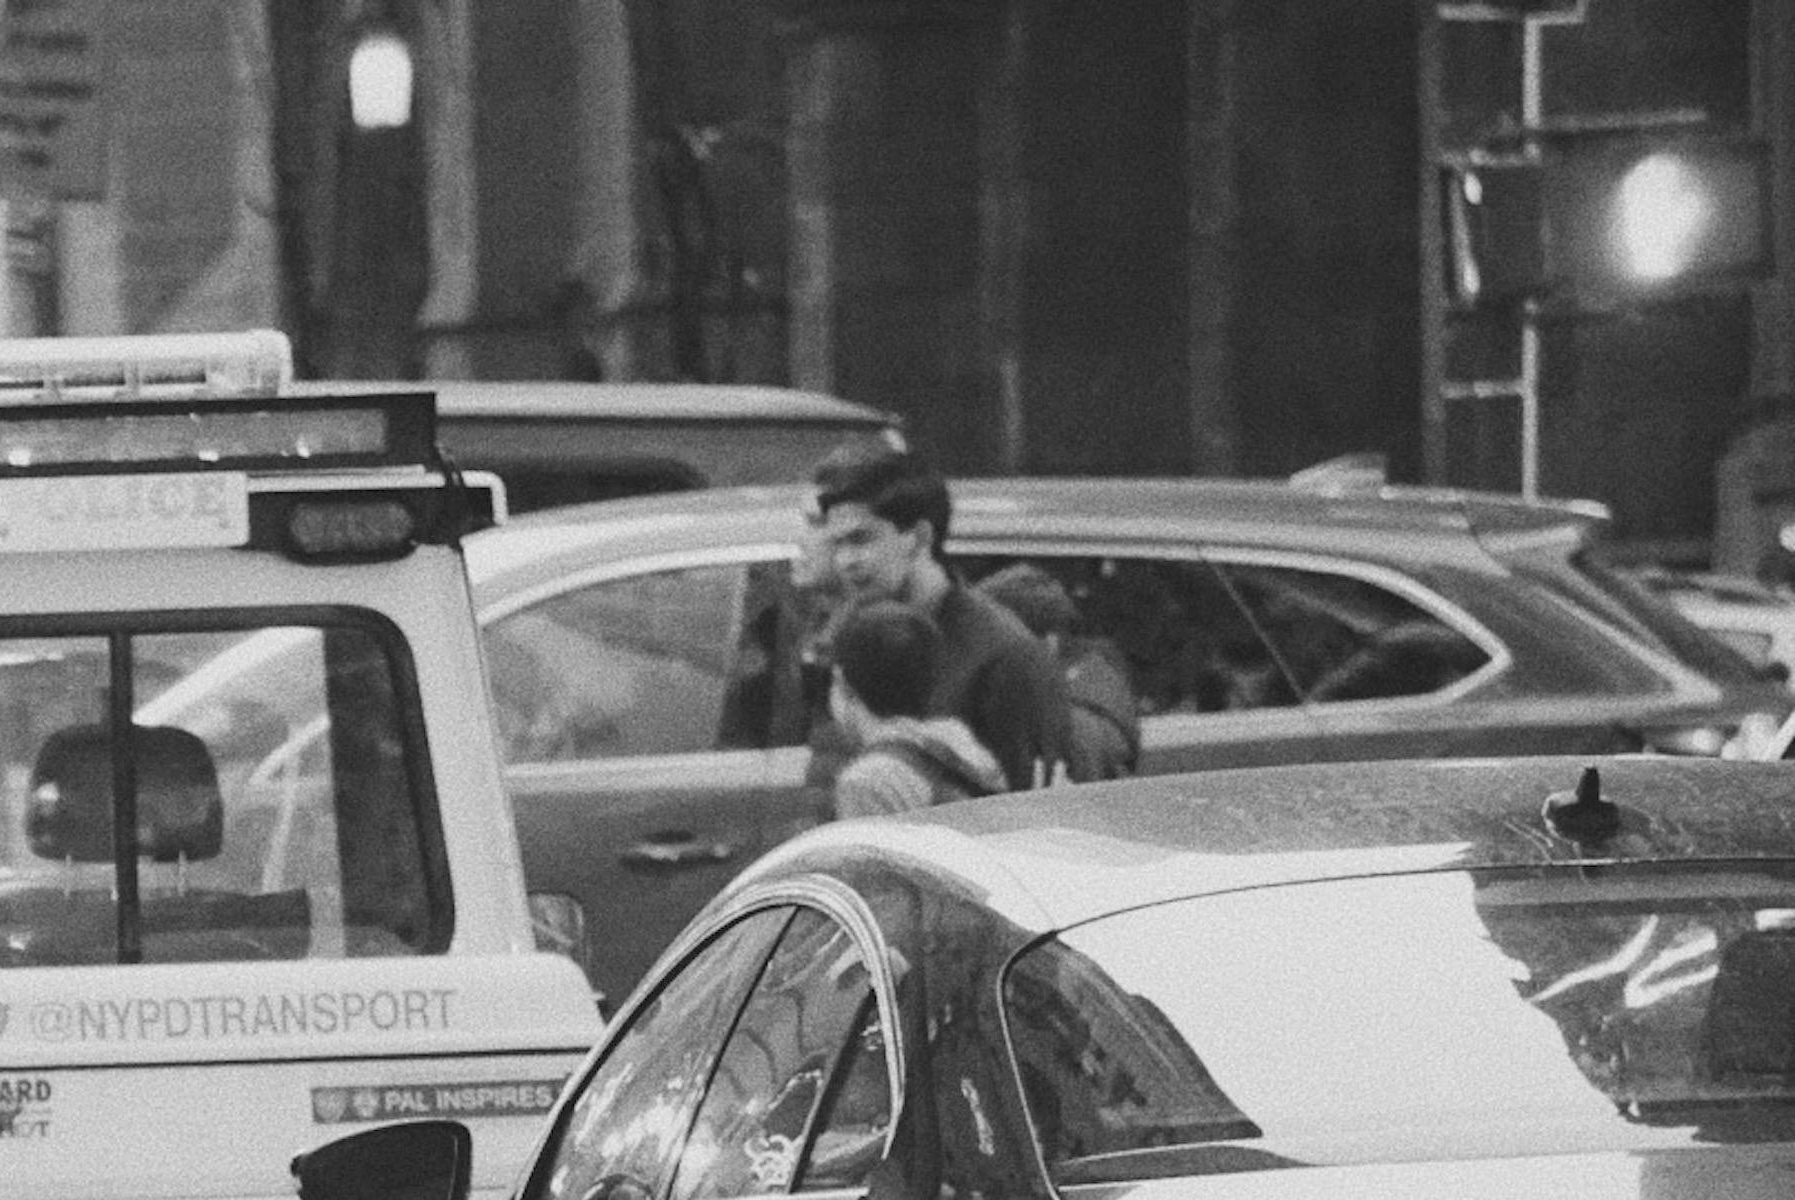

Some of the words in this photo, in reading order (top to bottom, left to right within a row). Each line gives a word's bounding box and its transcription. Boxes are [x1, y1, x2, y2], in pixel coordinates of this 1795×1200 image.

[29, 988, 458, 1043] @NYPDTRANSPORT
[385, 1091, 429, 1112] PAL
[436, 1086, 552, 1110] INSPIRES
